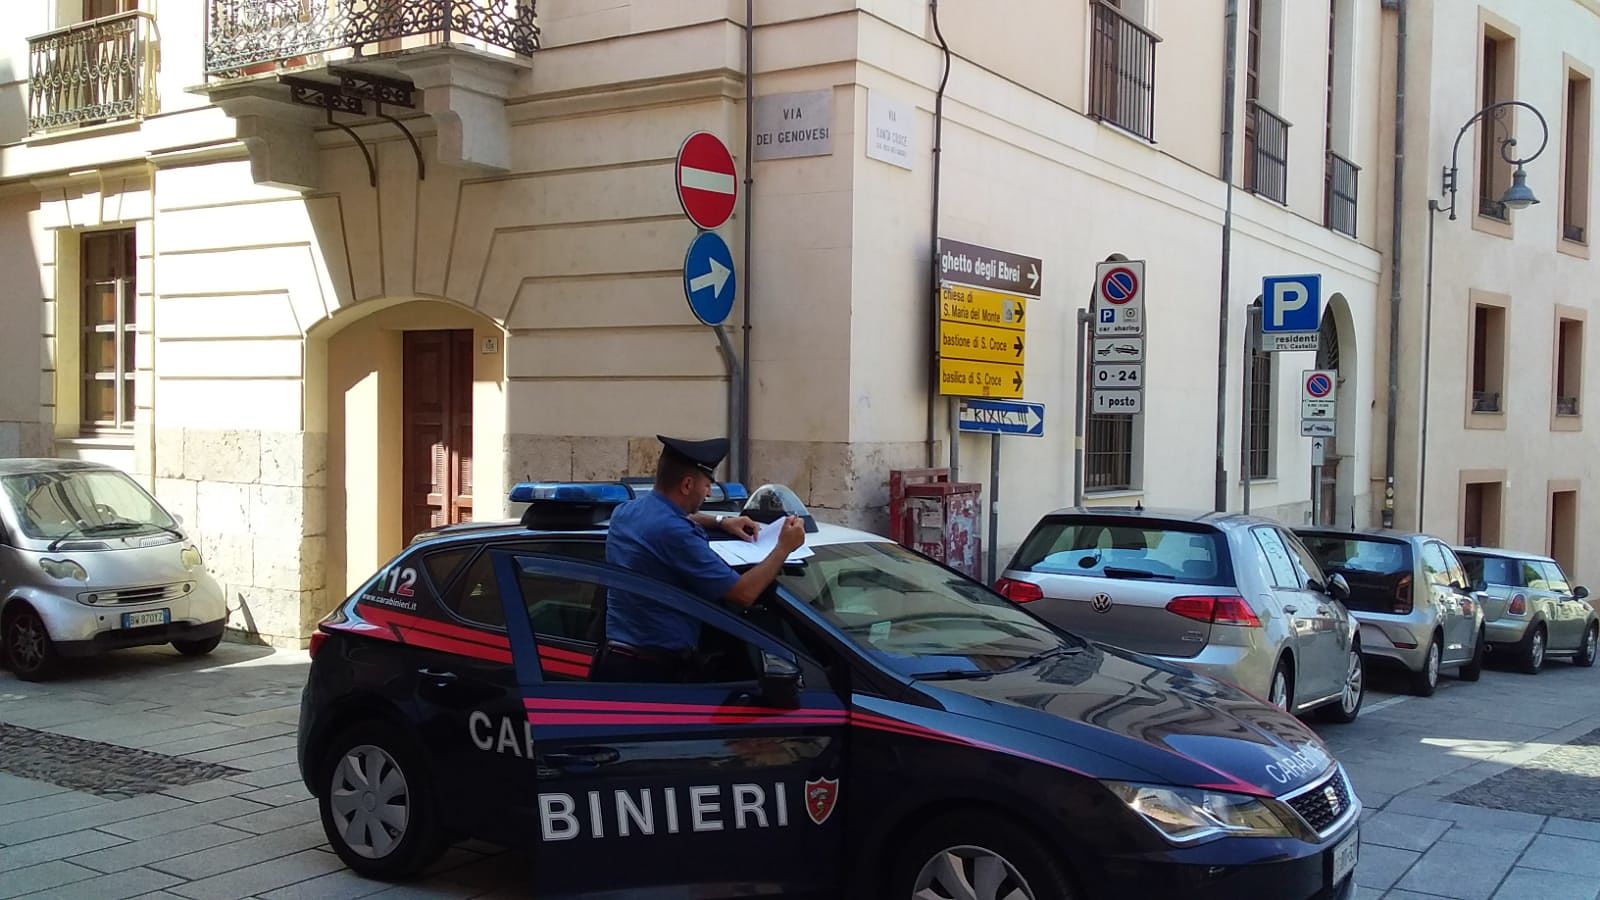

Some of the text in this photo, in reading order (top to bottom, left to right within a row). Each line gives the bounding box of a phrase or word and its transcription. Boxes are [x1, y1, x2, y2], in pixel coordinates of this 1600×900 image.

[783, 107, 802, 120] VIA
[756, 127, 829, 146] DEI GENOVESI
[942, 251, 1021, 282] ghetto degli Ebrei
[943, 288, 974, 303] chiesa di
[943, 303, 1001, 323] S. Maria del Monte
[1114, 325, 1140, 333] sharing
[943, 332, 1007, 352] bastione di S. Croce
[1275, 334, 1318, 343] residenti
[1290, 342, 1318, 350] Castello
[942, 370, 1002, 387] basilica di S. Croce
[1108, 396, 1135, 409] posto
[377, 566, 418, 597] 112
[537, 781, 789, 842] BINIERI
